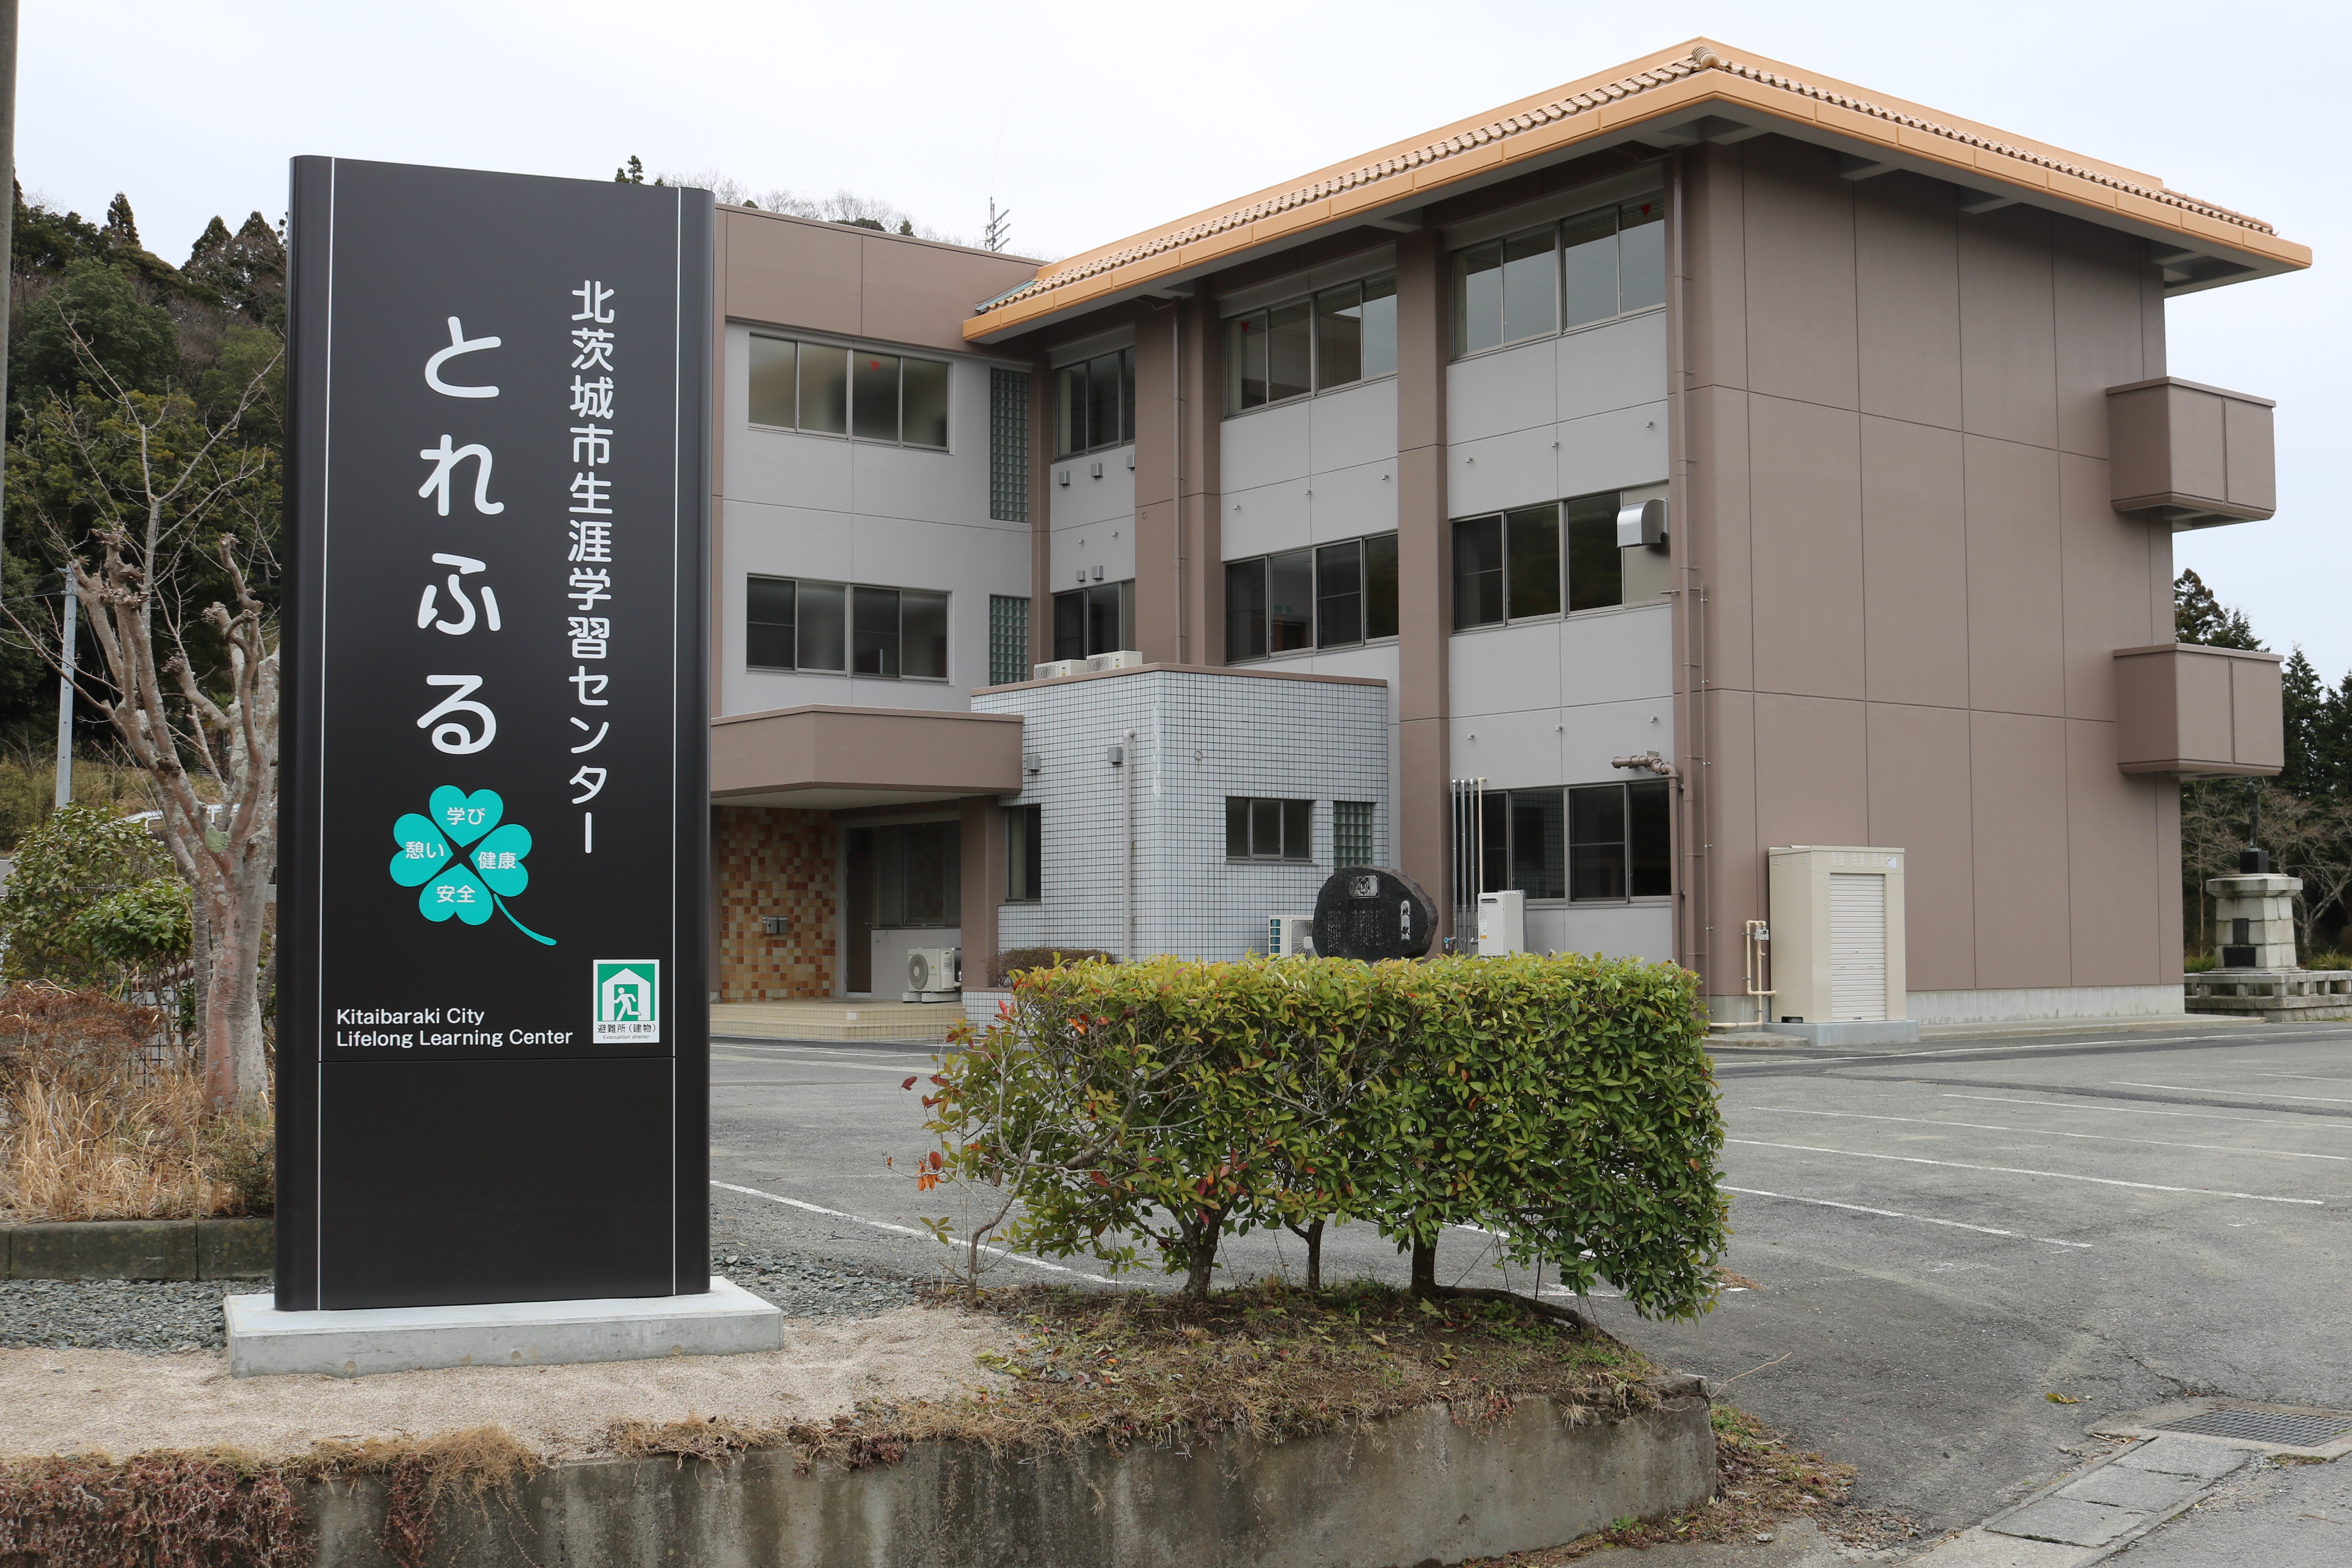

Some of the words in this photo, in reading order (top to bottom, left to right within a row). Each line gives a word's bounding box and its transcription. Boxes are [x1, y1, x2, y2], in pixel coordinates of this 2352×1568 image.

[416, 315, 505, 755] とれふる
[567, 279, 616, 854] 北茨城市生涯学習センター
[446, 807, 485, 825] 学び
[405, 841, 445, 860] 憩い
[478, 851, 517, 870] 健康
[436, 884, 476, 903] 安全
[337, 1008, 440, 1025] Kitaibaraki
[446, 1008, 485, 1027] City
[337, 1030, 413, 1048] Lifelong
[420, 1029, 504, 1047] Learning
[509, 1028, 573, 1045] Center
